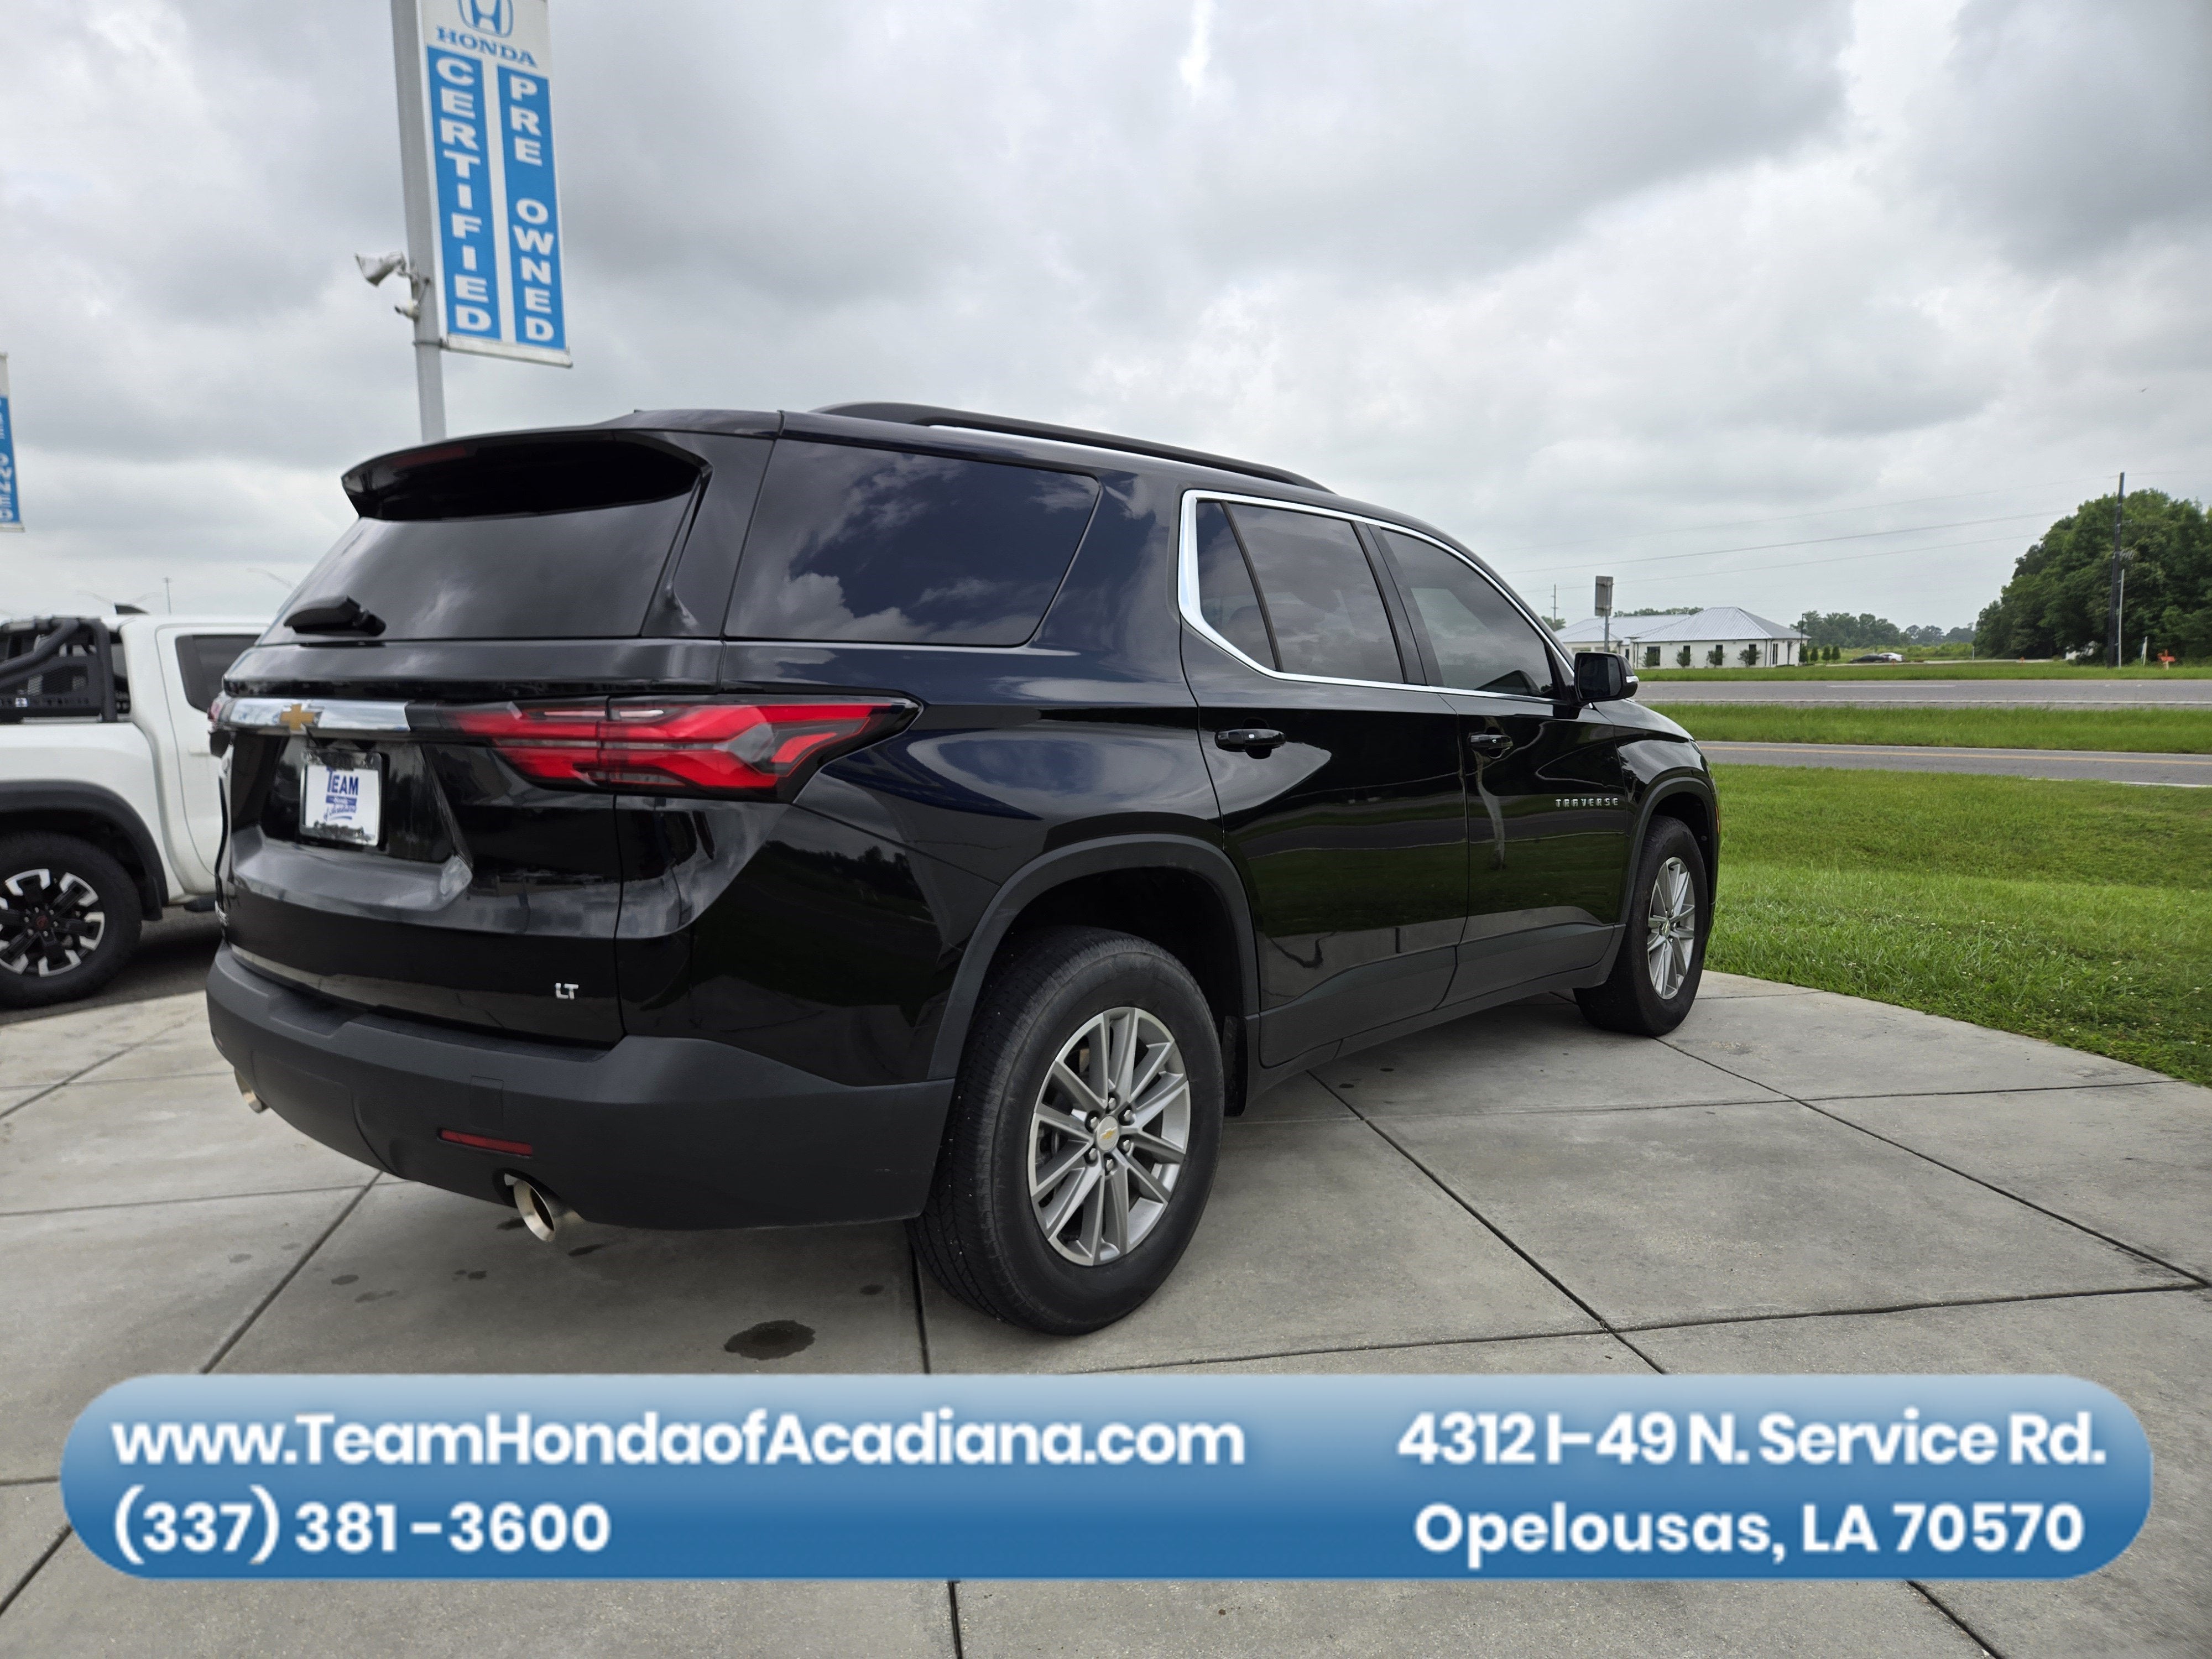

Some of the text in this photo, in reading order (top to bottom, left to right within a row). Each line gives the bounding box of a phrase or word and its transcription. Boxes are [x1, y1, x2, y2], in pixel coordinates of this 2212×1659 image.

[437, 25, 538, 69] HONDA
[436, 58, 491, 332] CERTIFIED
[509, 75, 554, 342] PRE OWNED
[326, 766, 359, 795] TEAM
[1555, 797, 1618, 807] TRAVERSE
[555, 982, 579, 999] LT
